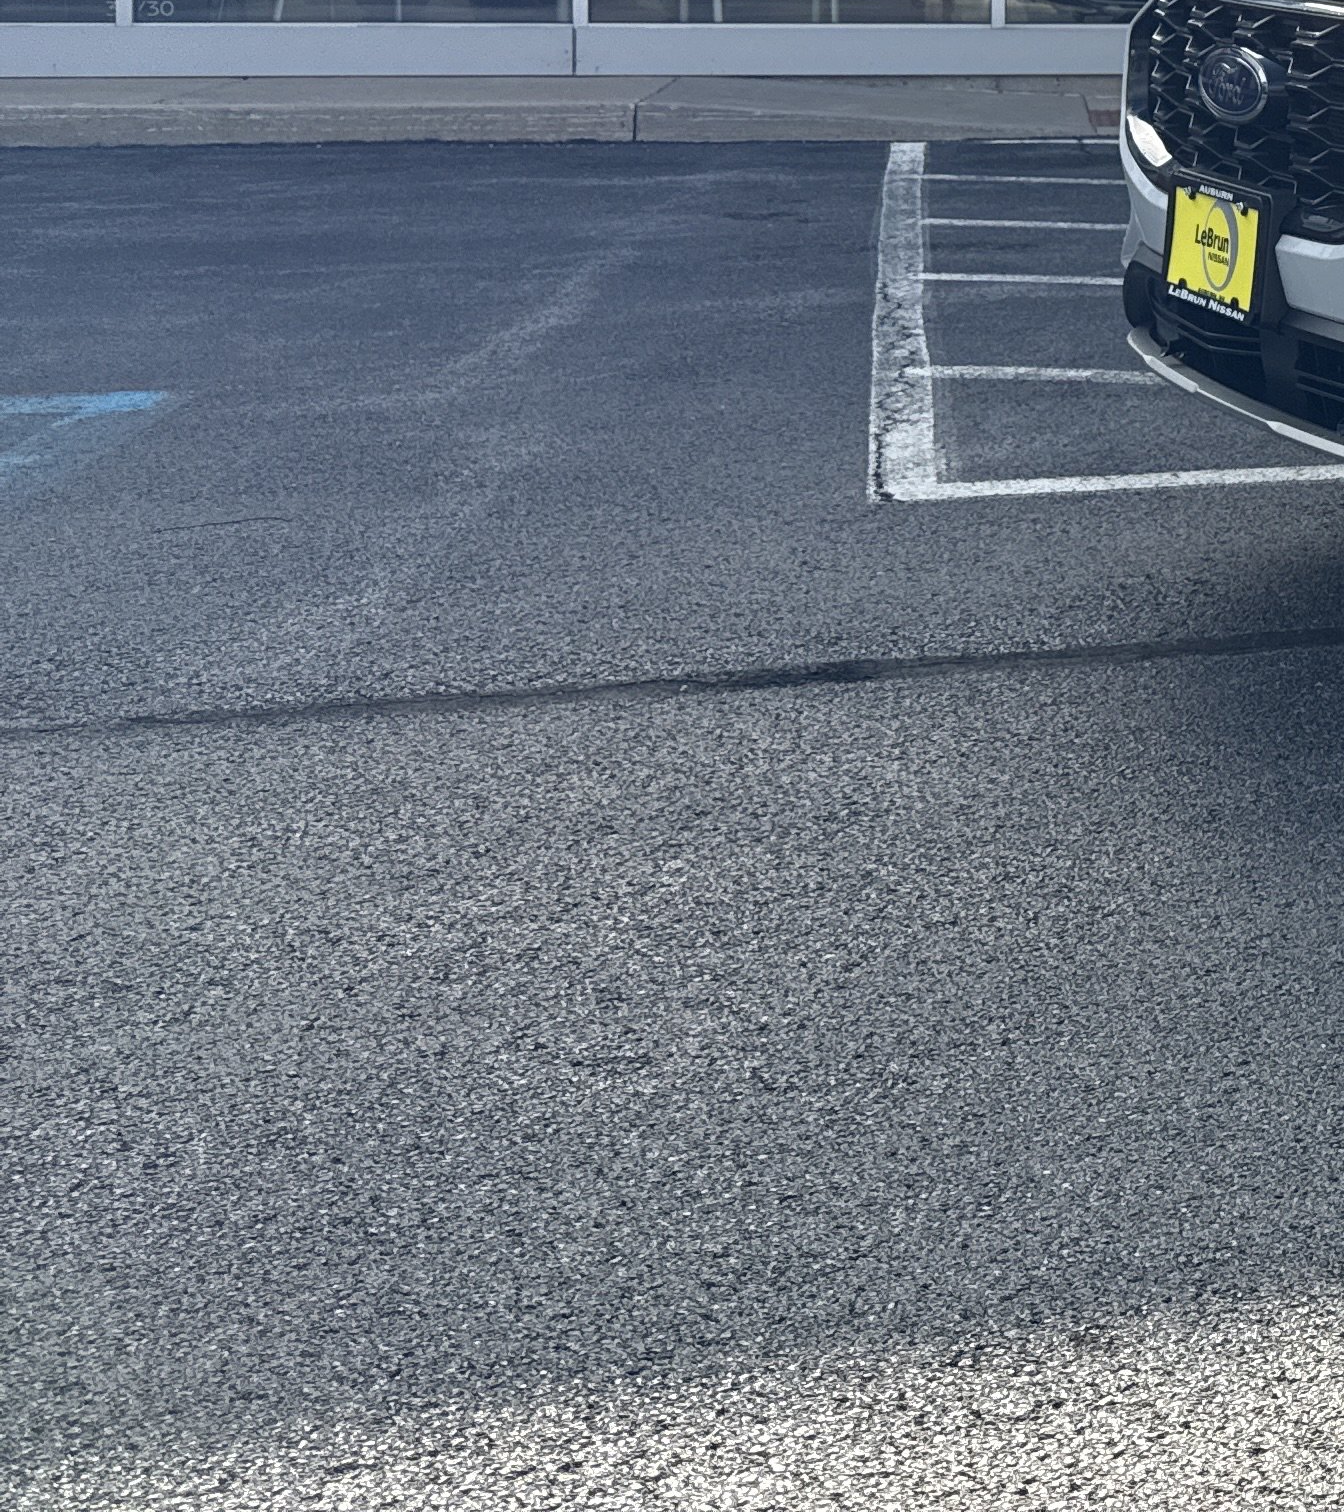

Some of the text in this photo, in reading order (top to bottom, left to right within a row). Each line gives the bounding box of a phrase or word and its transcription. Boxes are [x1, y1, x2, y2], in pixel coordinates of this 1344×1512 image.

[1199, 184, 1234, 202] AUBURN
[1194, 223, 1229, 254] LeBrun
[1207, 252, 1229, 267] NISSAN
